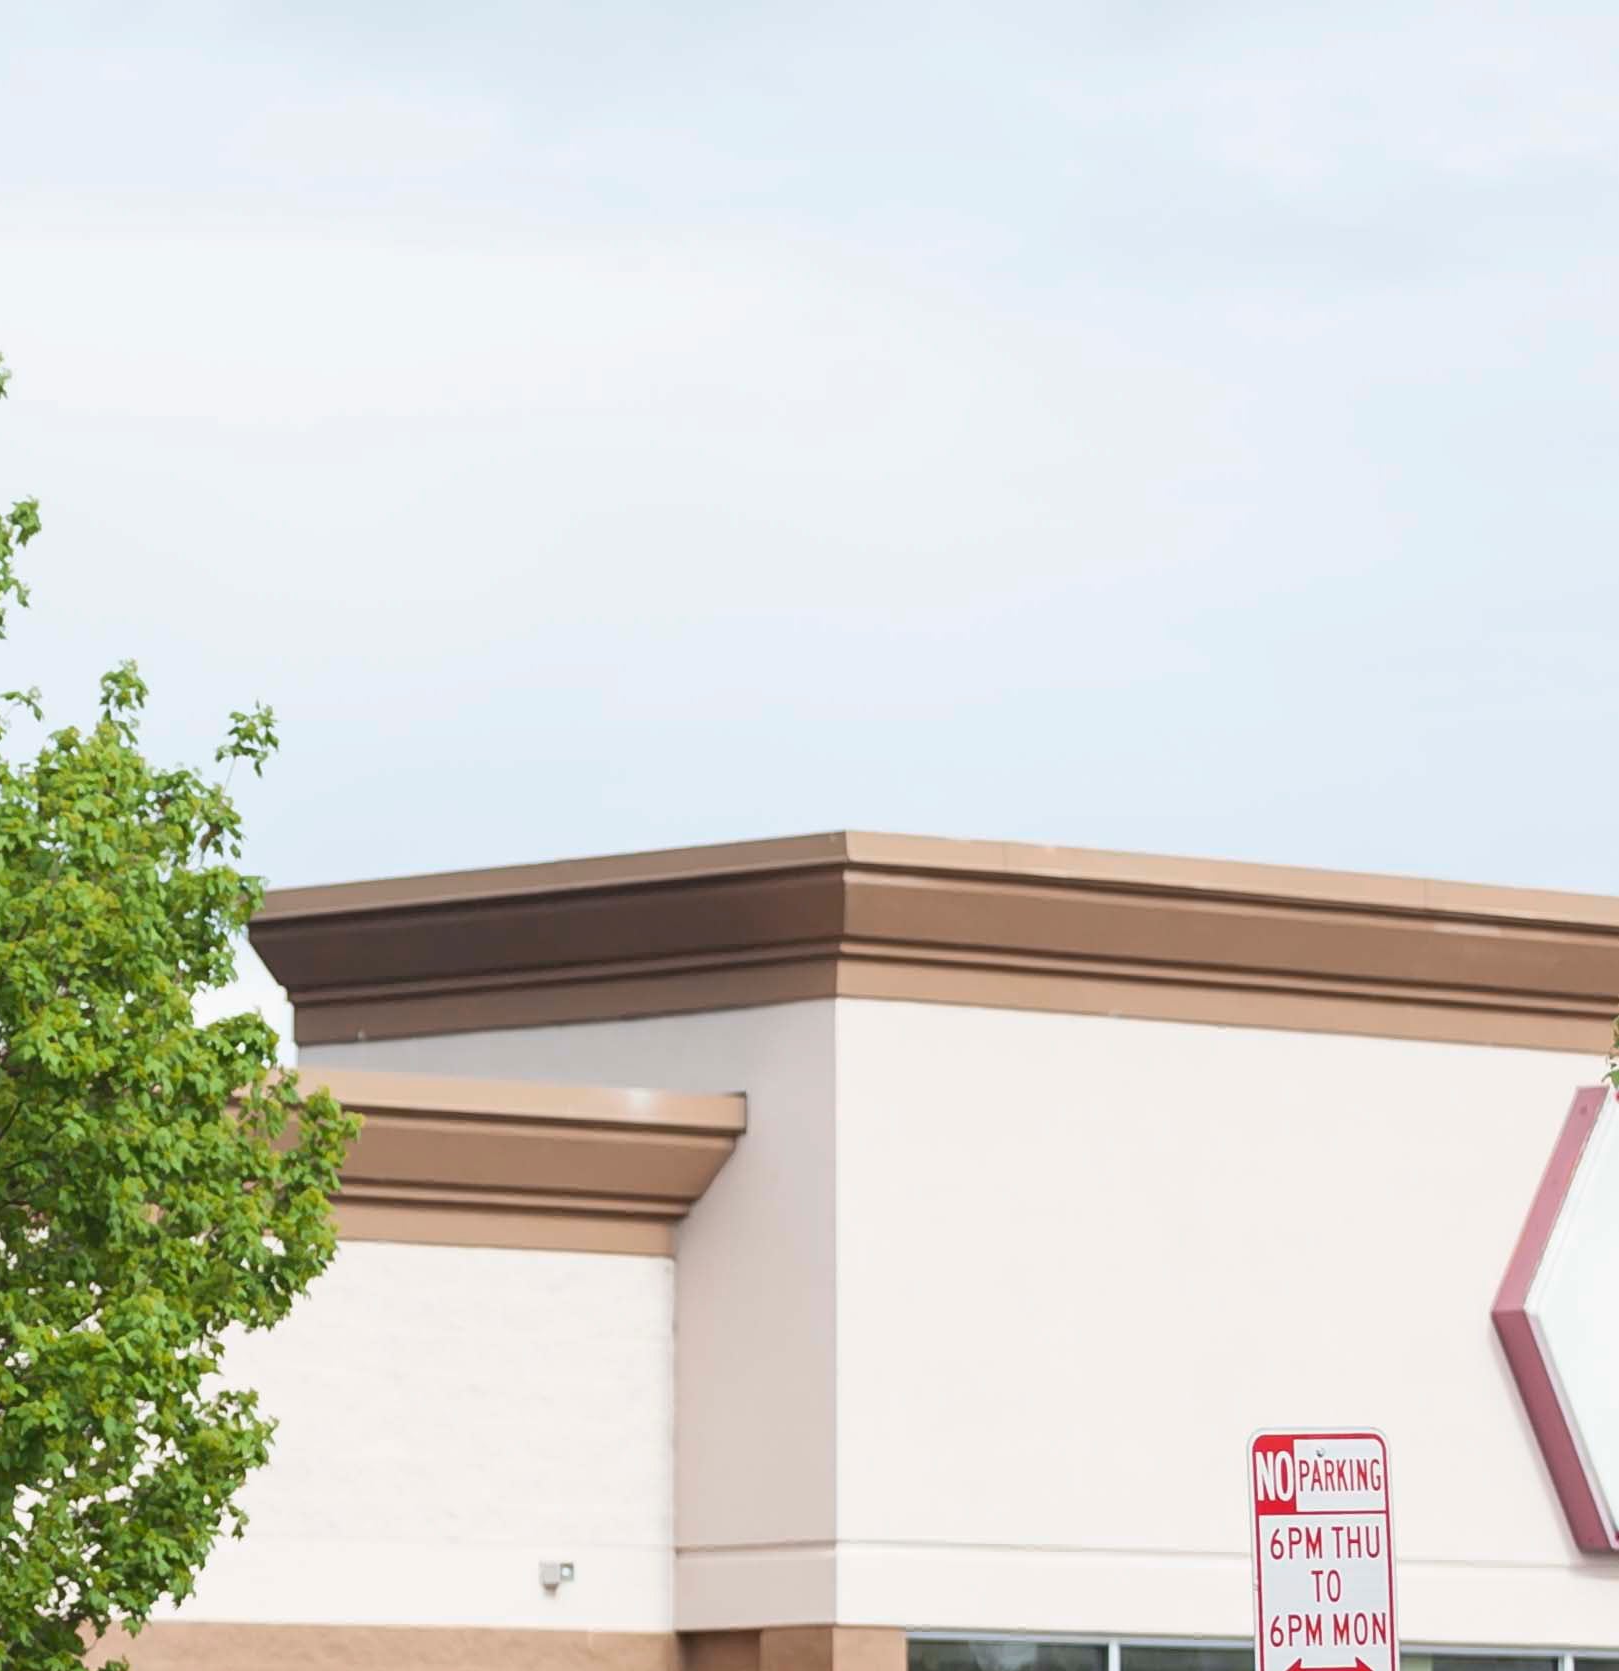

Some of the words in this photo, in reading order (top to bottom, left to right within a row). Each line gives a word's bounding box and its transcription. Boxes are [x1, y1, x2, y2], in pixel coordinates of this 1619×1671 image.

[1255, 1450, 1294, 1502] NO
[1298, 1458, 1383, 1493] PARKING
[1270, 1525, 1323, 1560] 6PM
[1330, 1525, 1381, 1559] THU
[1311, 1569, 1342, 1603] TO
[1270, 1613, 1323, 1647] 6PM
[1333, 1612, 1387, 1646] MON
